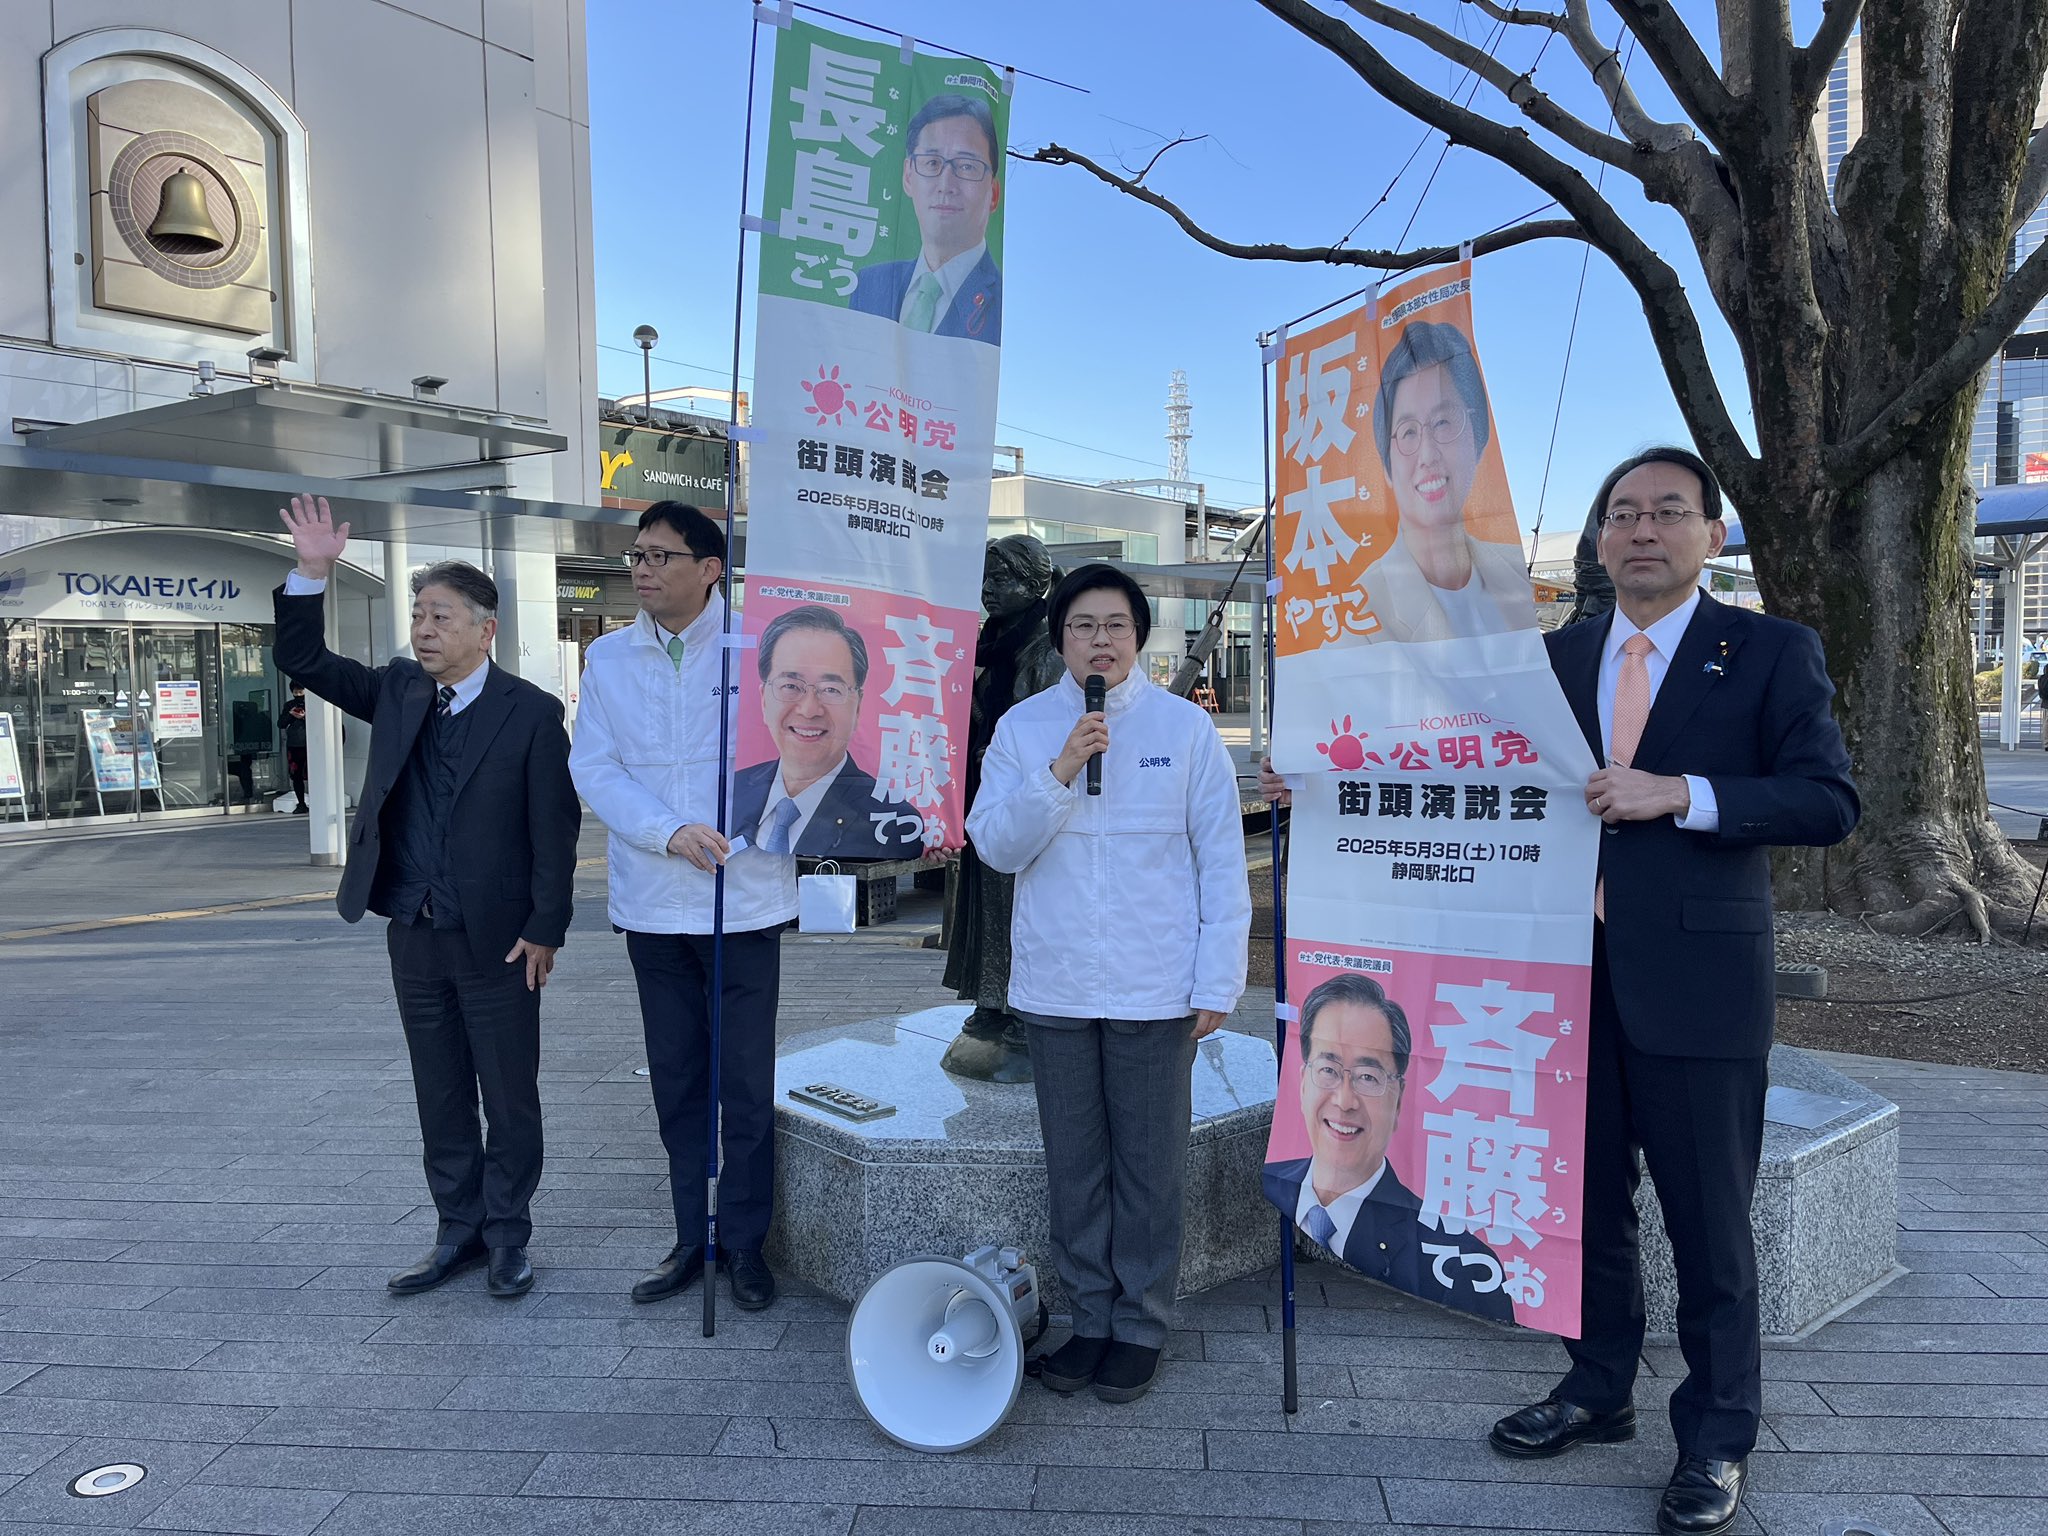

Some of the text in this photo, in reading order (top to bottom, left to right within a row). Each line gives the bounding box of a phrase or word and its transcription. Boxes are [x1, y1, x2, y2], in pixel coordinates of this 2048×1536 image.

[779, 42, 886, 257] 長島
[791, 251, 859, 297] ごう
[888, 386, 933, 411] KOMEITO
[864, 400, 957, 451] 公明党
[797, 438, 950, 501] 街頭演説会
[1283, 331, 1358, 586] 坂本
[643, 469, 692, 488] SANDWICH
[693, 478, 700, 488] &
[847, 513, 911, 539] 静岡駅北口
[57, 572, 241, 599] TOKAIモバイル
[80, 600, 107, 609] TOKAI
[556, 585, 600, 599] SUBWAY
[1284, 589, 1379, 640] やすこ
[711, 685, 740, 696] 公党
[871, 614, 954, 807] 斉藤
[1420, 712, 1492, 731] KOMEITO
[1138, 756, 1172, 768] 公明党
[1389, 729, 1539, 770] 公明党
[1337, 780, 1549, 821] 街頭演説会
[870, 811, 947, 848] てつお
[1391, 861, 1475, 884] 静岡駅北口
[1417, 978, 1558, 1250] 斉藤
[1421, 1241, 1548, 1309] てつお
